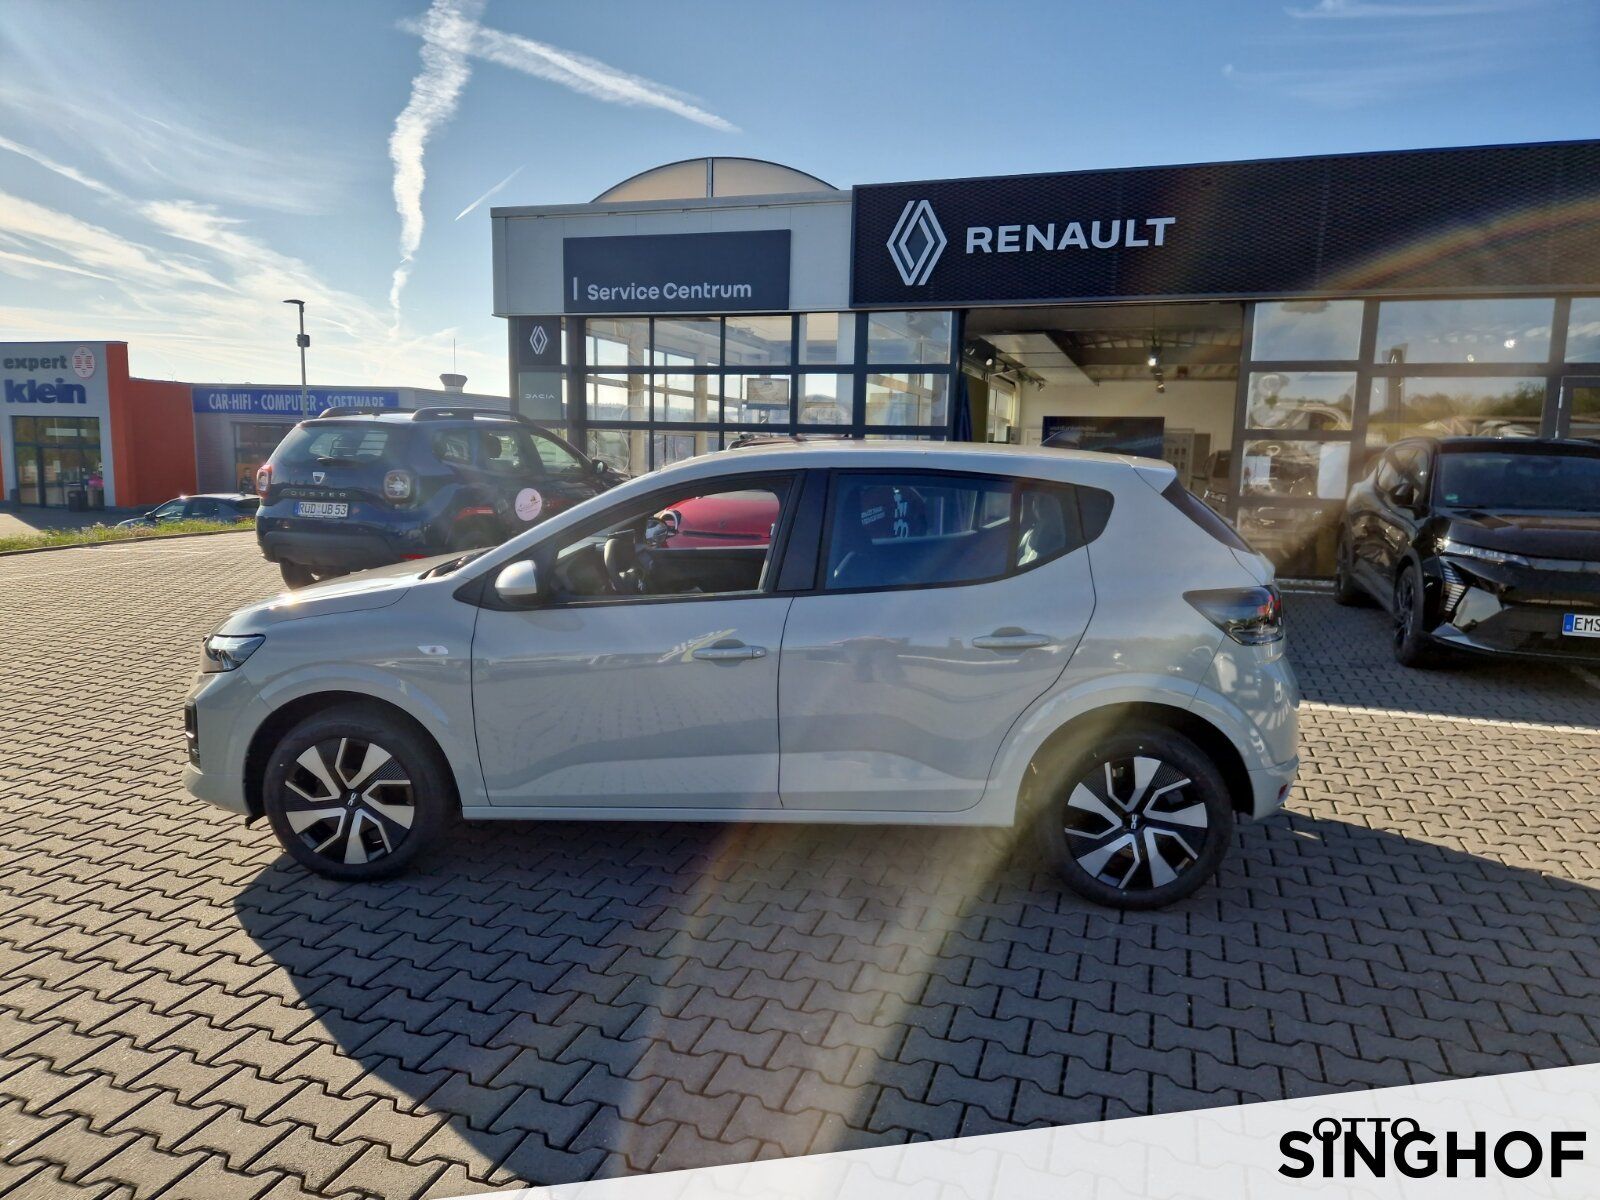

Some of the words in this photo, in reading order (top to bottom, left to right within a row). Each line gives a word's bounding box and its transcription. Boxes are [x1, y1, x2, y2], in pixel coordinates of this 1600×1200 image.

[965, 216, 1177, 255] RENAULT
[587, 282, 660, 301] Service
[662, 282, 752, 300] Centrum
[3, 355, 68, 372] expert
[4, 377, 87, 404] klein
[208, 393, 251, 410] CAR-HIFI
[321, 503, 333, 515] UB
[334, 504, 347, 516] 53
[1574, 617, 1600, 631] EMS
